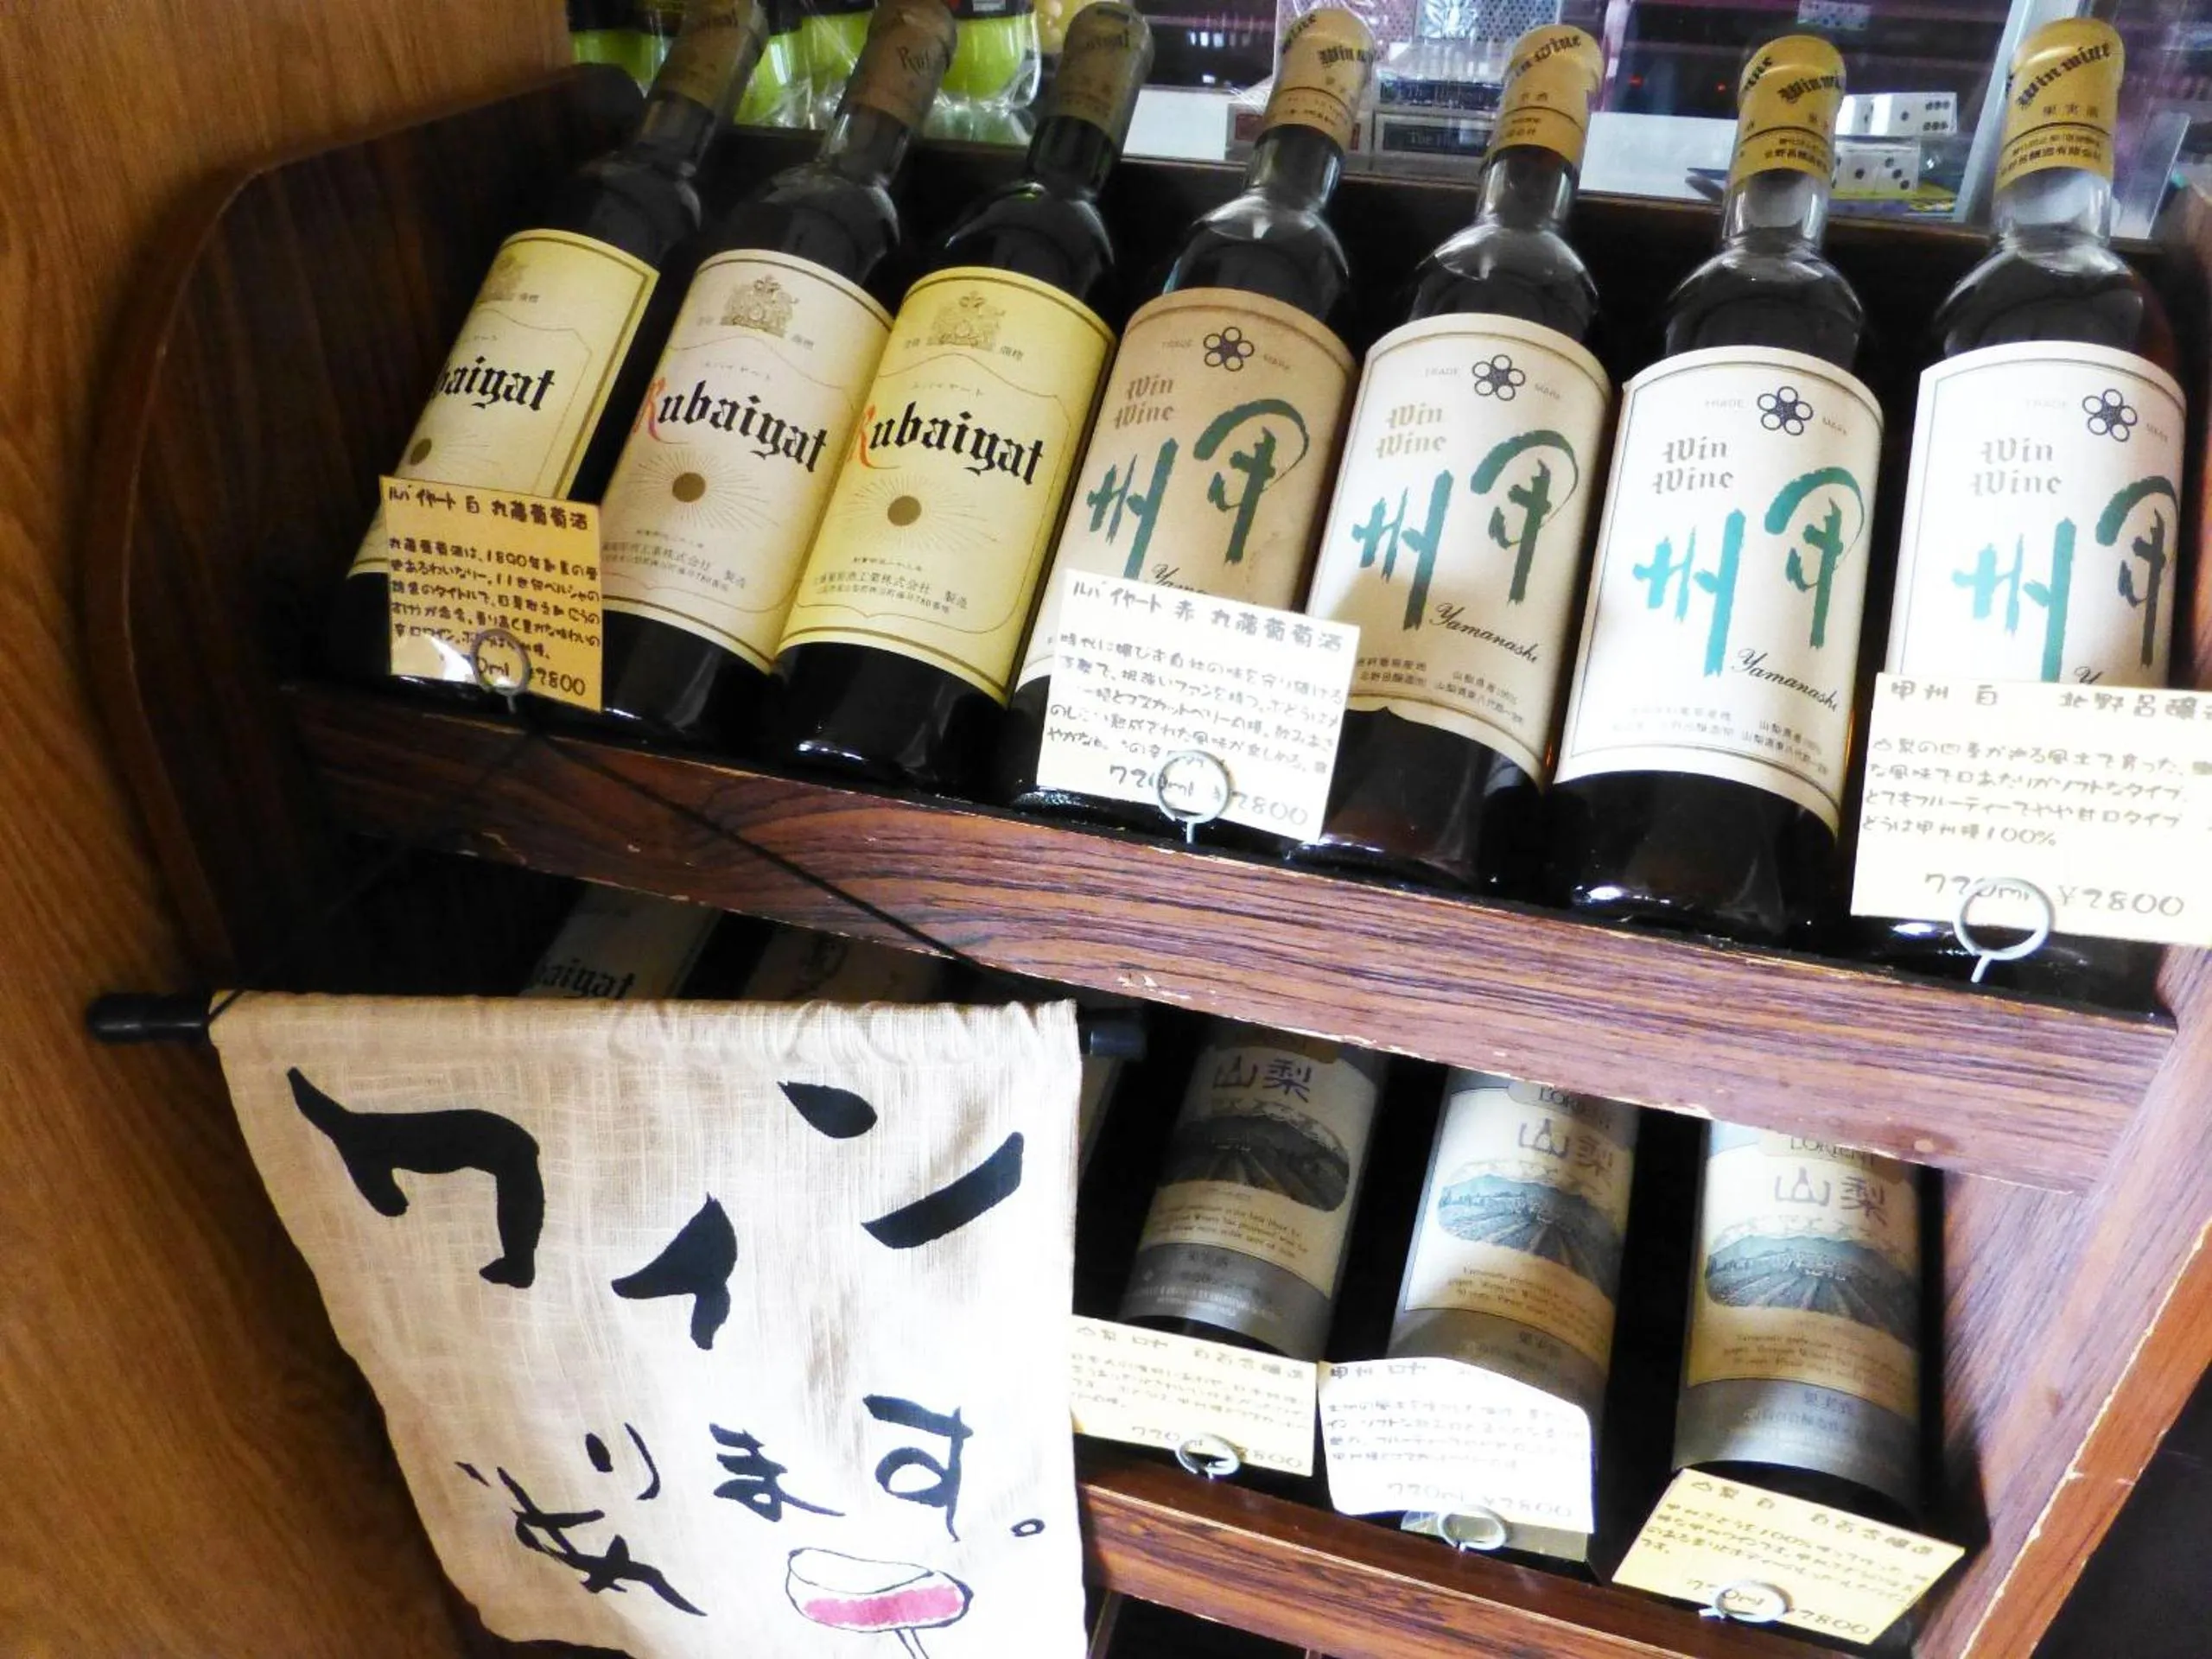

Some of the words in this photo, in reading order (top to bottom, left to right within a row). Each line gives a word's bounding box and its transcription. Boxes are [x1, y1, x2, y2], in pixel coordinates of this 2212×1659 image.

[1126, 373, 1174, 401] Win
[1115, 400, 1175, 429] Wine
[1385, 402, 1446, 429] Win
[1376, 432, 1448, 460] Wine
[1662, 436, 1729, 464] Win
[1980, 436, 2054, 464] Win
[1652, 467, 1734, 494] Wine
[1970, 469, 2063, 497] Wine
[1428, 602, 1539, 664] Yamanashi
[1731, 647, 1838, 713] Yamanashi
[1891, 680, 1949, 702] 甲州
[1775, 1166, 1888, 1225] 山梨
